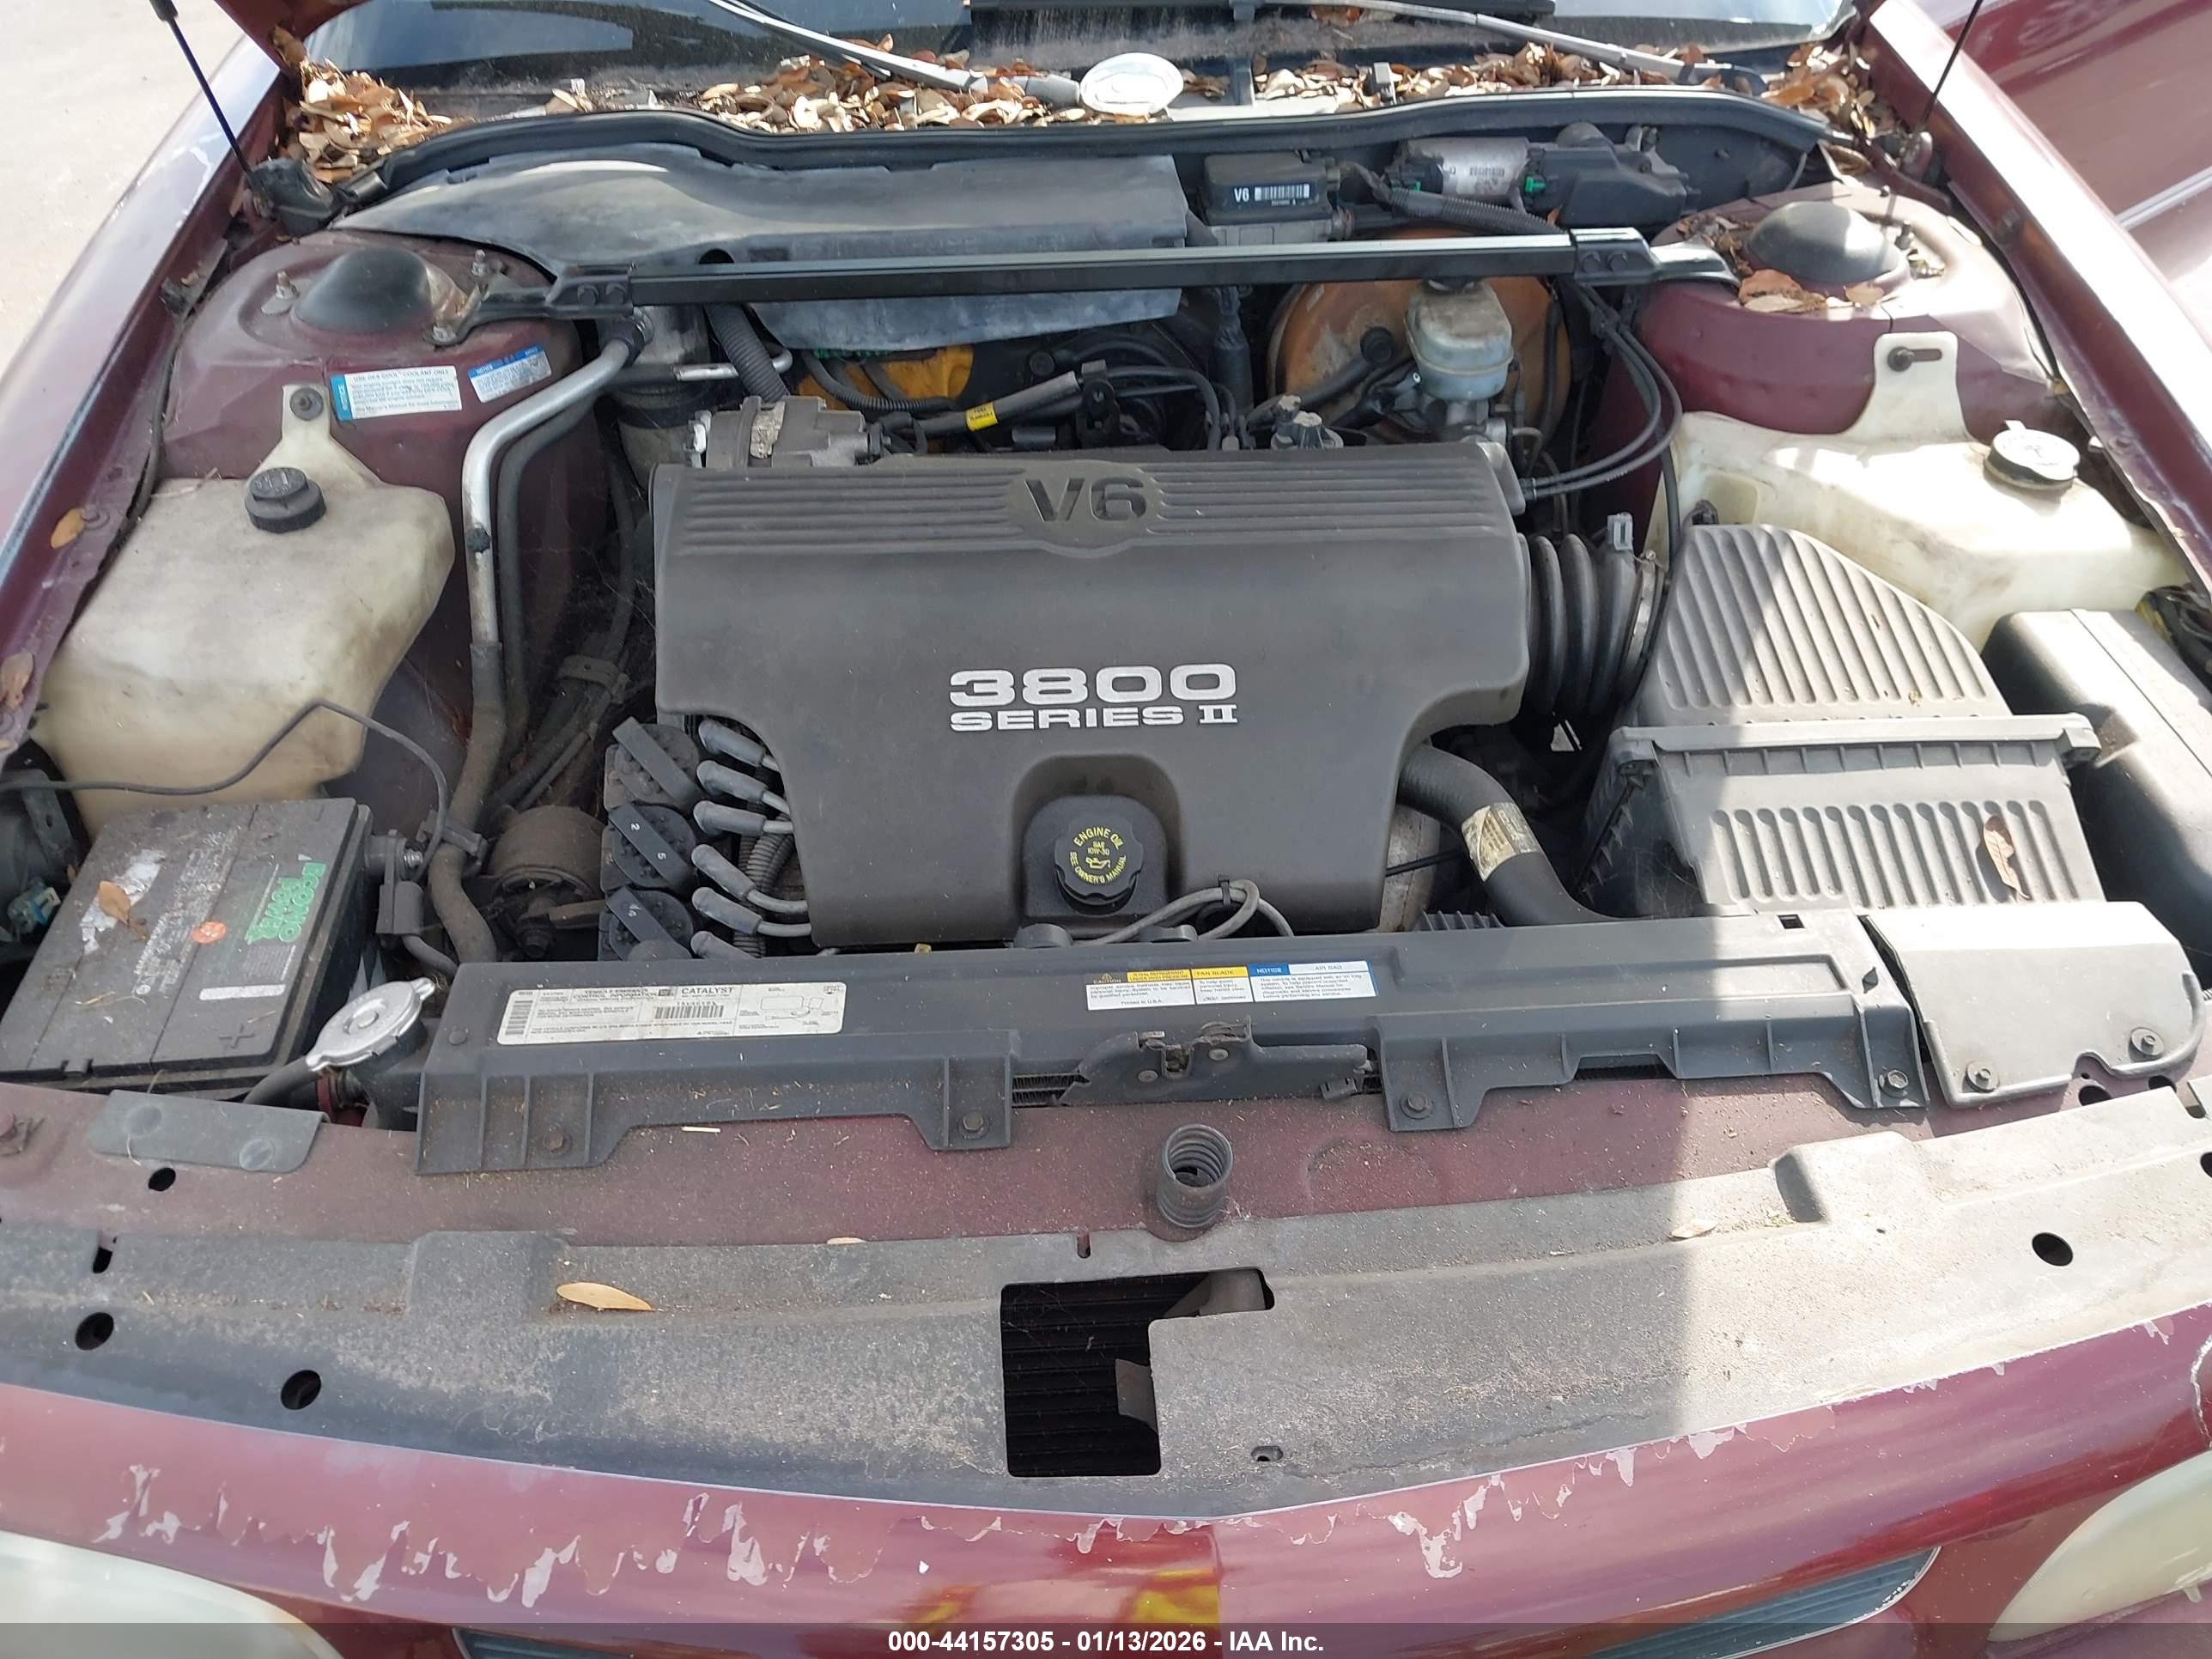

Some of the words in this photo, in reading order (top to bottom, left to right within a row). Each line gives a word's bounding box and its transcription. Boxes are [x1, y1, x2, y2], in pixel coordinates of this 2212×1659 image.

[1234, 187, 1249, 203] V6
[1024, 476, 1147, 523] V6
[950, 663, 1237, 708] 3800
[950, 705, 1184, 732] SERIES
[1197, 703, 1237, 725] II
[1073, 827, 1111, 848] ENGINE
[1110, 833, 1124, 851] OIL
[1105, 854, 1127, 883] MANUAL
